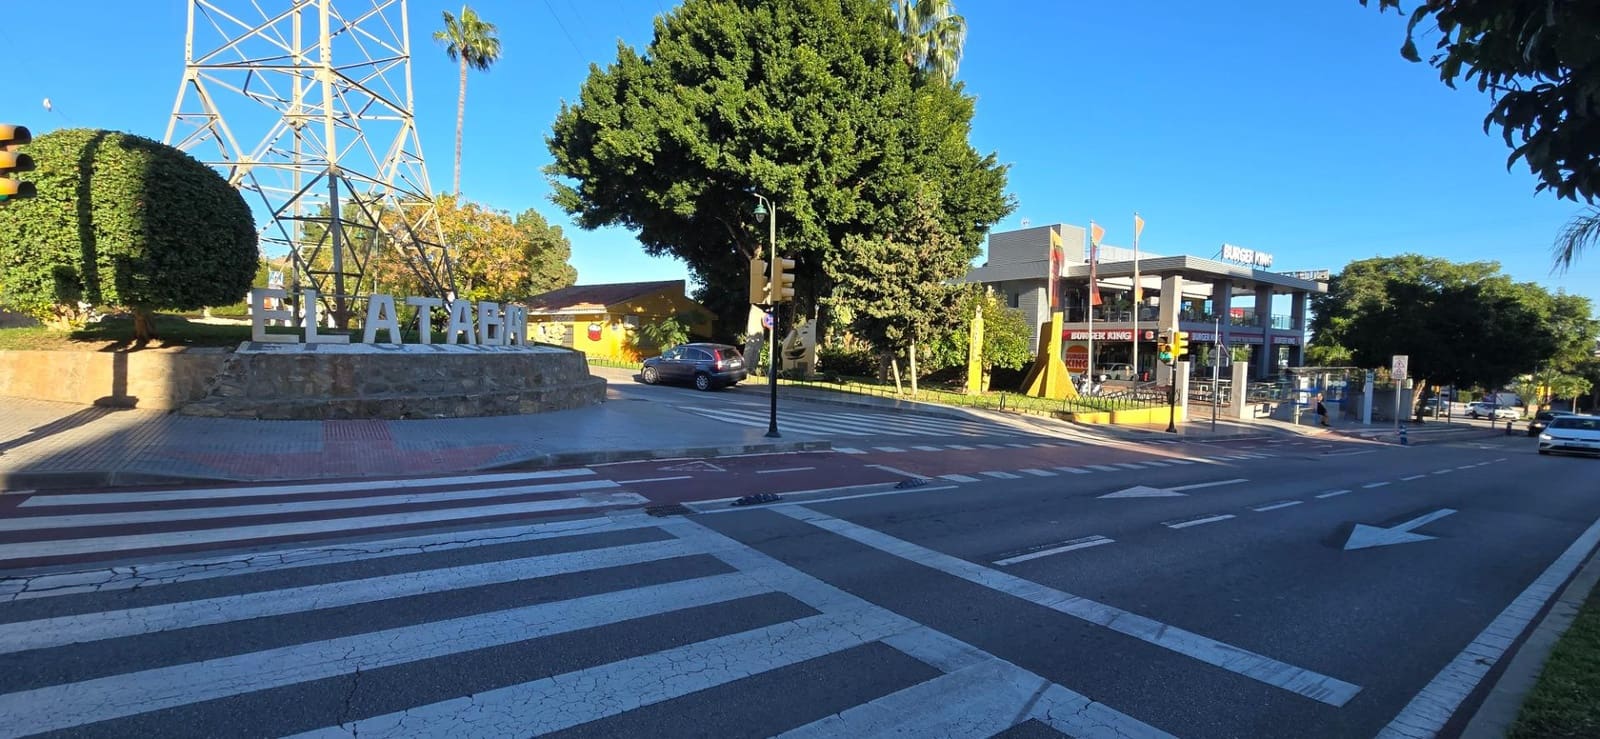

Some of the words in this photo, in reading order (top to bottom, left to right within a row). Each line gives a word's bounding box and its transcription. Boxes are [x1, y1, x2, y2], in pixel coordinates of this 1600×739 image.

[1223, 243, 1254, 265] BURGER
[1254, 250, 1273, 267] KING
[252, 288, 350, 344] EL
[1070, 331, 1106, 340] BURGER
[1106, 331, 1132, 340] KING
[1065, 359, 1088, 368] KING
